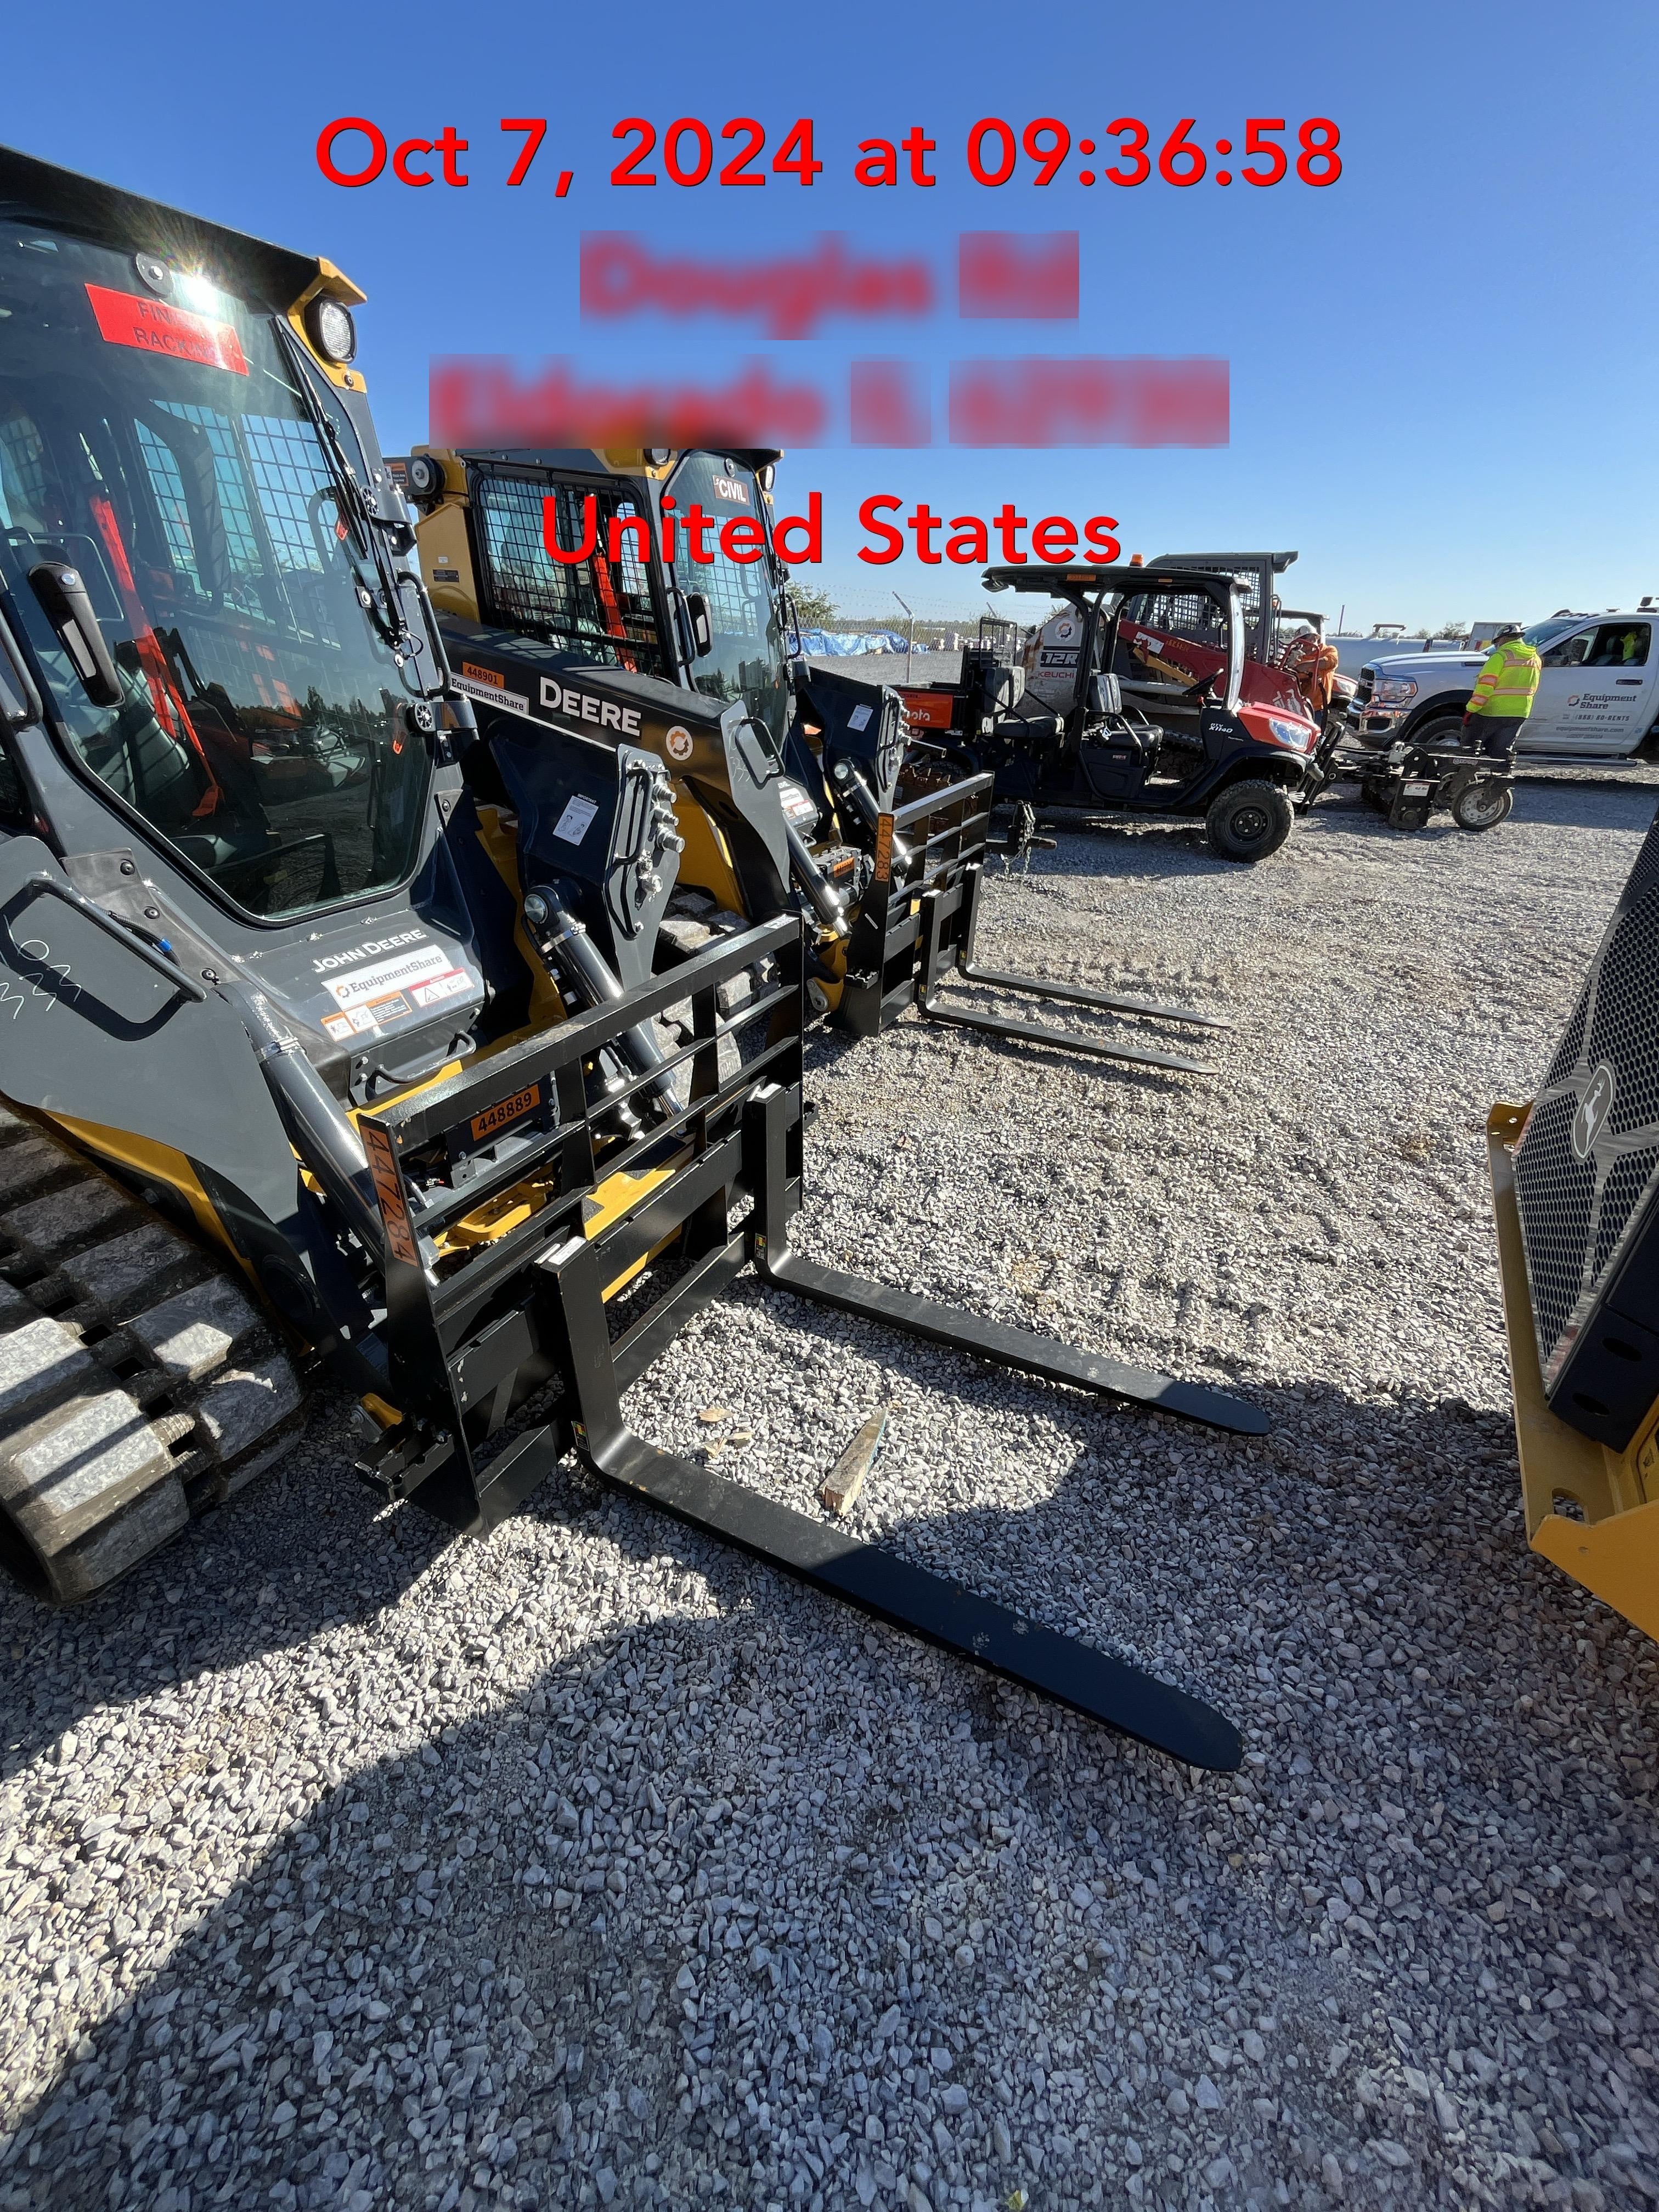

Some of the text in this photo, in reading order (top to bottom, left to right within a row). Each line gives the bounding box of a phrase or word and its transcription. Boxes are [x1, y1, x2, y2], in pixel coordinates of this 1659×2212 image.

[719, 479, 747, 503] CIVIL
[452, 678, 524, 711] EquipmentShare
[466, 665, 499, 685] 448901
[540, 676, 641, 737] DEERE
[1582, 693, 1637, 702] Equipment
[877, 817, 892, 879] 447283
[312, 929, 427, 973] JOHN DEERE
[348, 955, 443, 993] EquipmentShare
[477, 1092, 532, 1132] 448889
[366, 1131, 416, 1261] 447284
